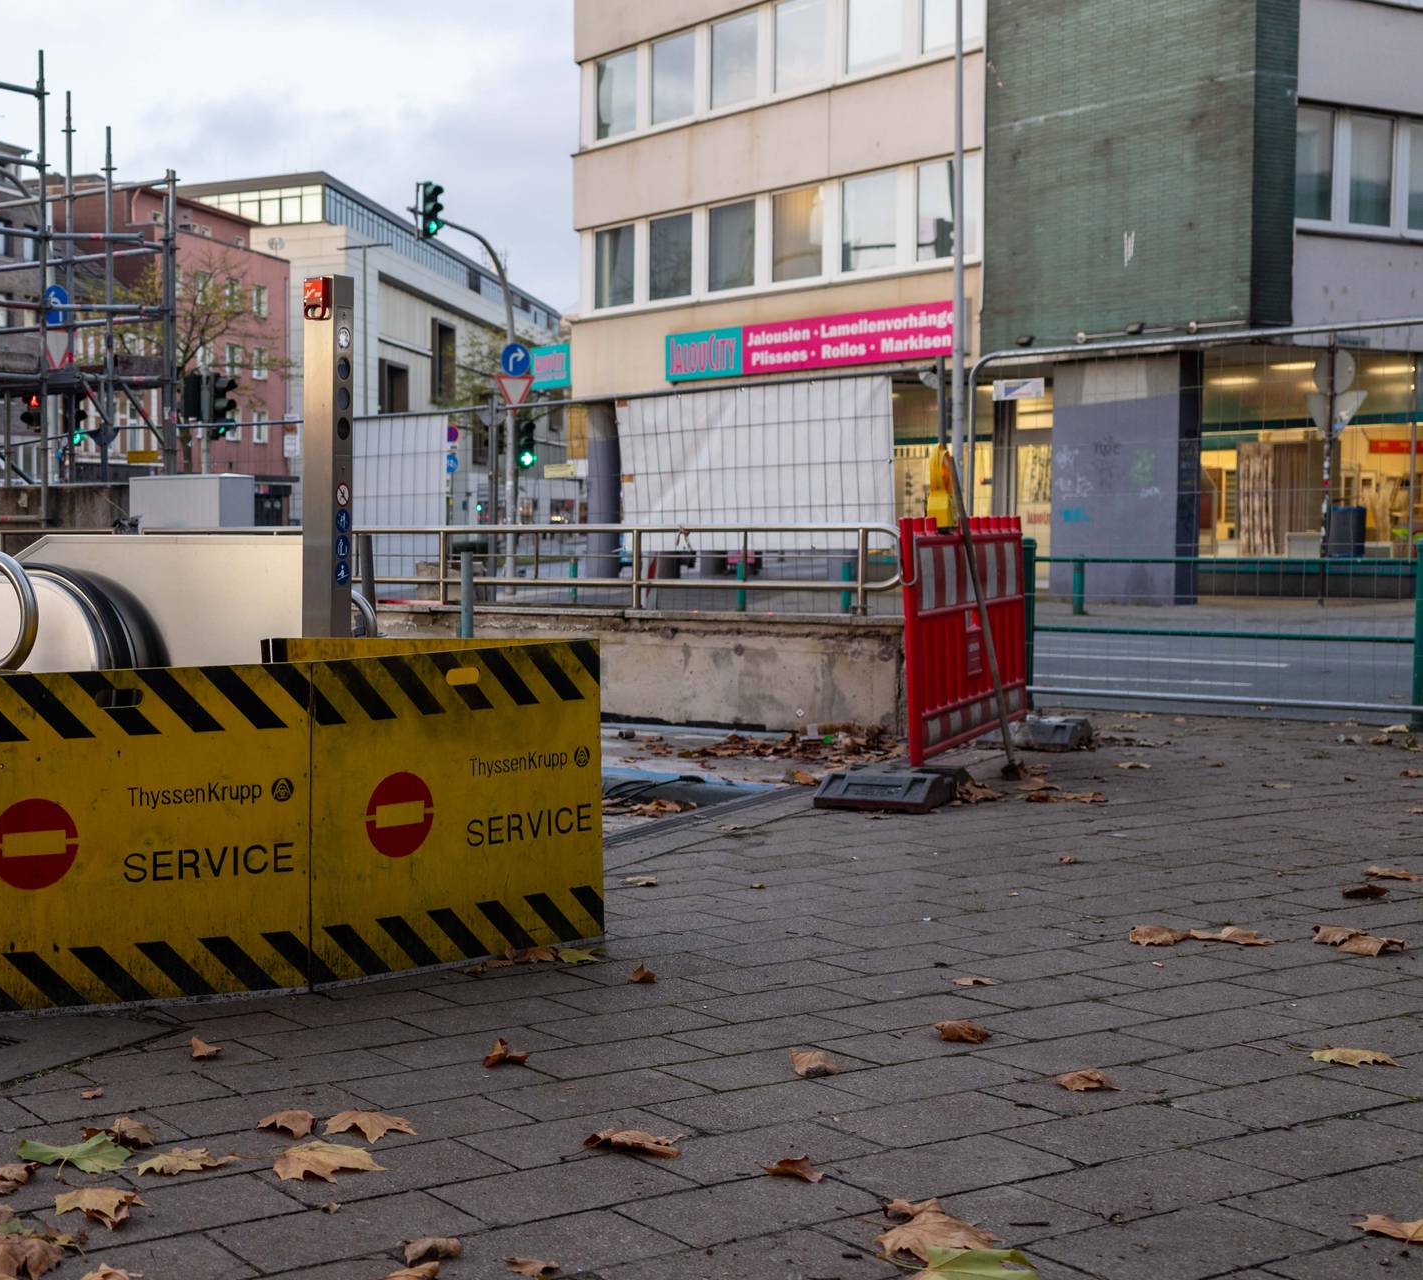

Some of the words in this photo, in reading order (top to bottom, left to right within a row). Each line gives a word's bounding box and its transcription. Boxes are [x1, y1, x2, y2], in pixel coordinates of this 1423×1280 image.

[747, 327, 811, 347] Jalousien
[751, 350, 808, 367] Plissees
[821, 343, 867, 360] Rollos
[880, 333, 952, 354] Markisen
[469, 751, 568, 778] ThyssenKrupp
[127, 782, 262, 810] ThyssenKrupp
[466, 803, 593, 847] SERVICE
[123, 842, 295, 883] SERVICE
